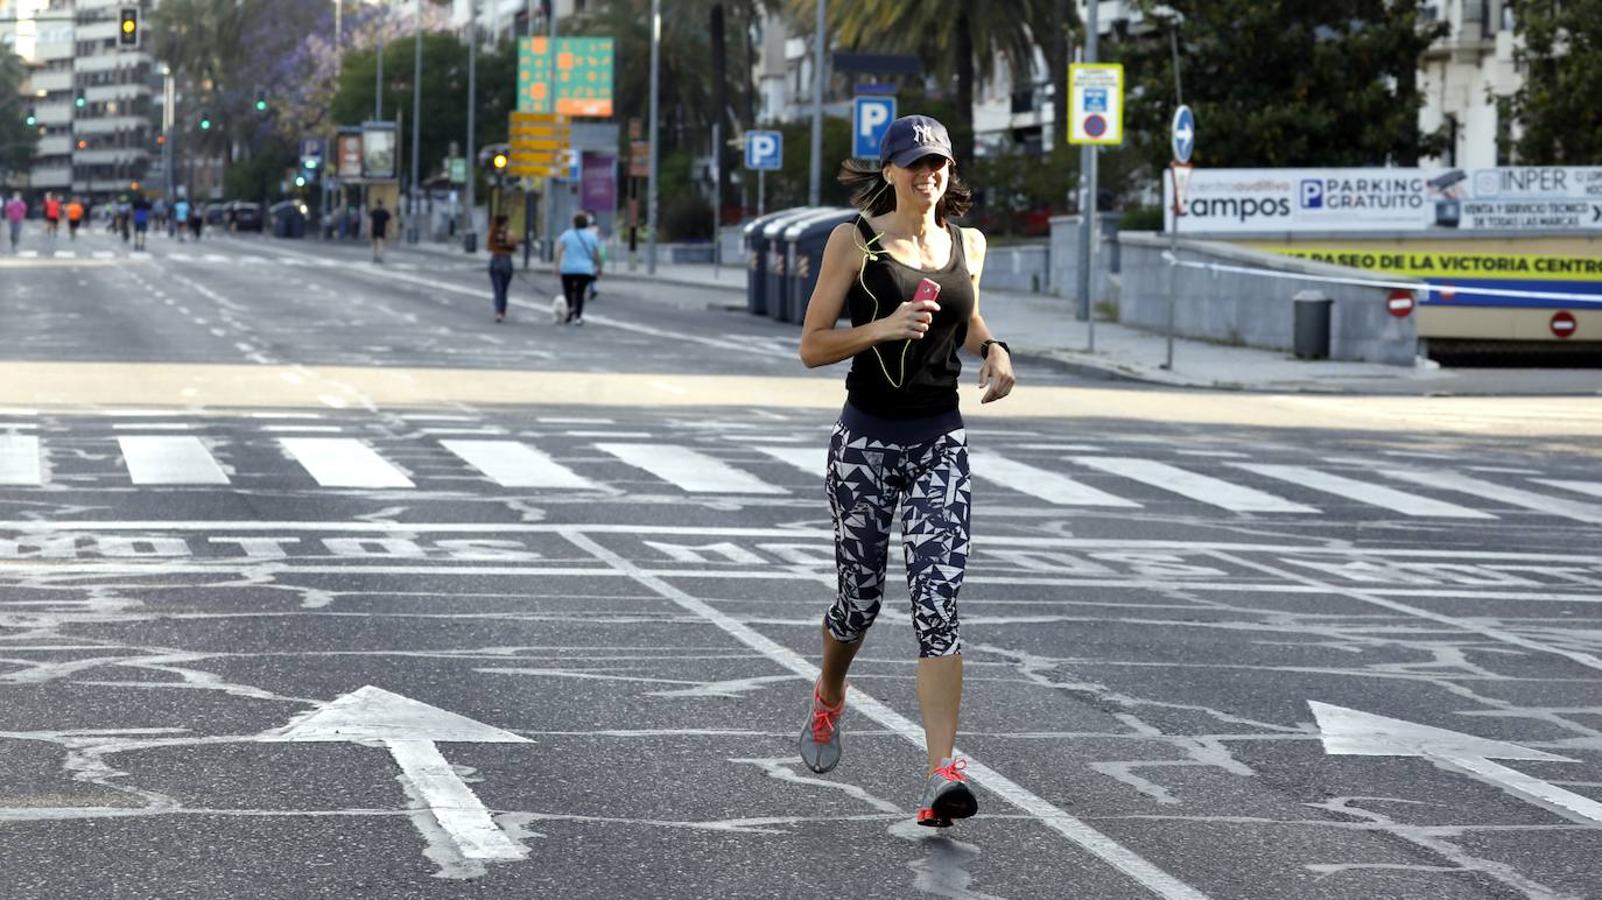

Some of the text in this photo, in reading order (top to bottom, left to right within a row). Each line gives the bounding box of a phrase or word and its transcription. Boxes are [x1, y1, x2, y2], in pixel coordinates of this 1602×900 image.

[861, 102, 888, 136] P
[752, 136, 775, 164] P
[1326, 179, 1423, 192] PARKING
[1502, 168, 1568, 191] INPER
[1326, 194, 1423, 208] GRATUITO
[1505, 203, 1546, 214] SERVICIO
[1488, 216, 1517, 226] TODAS
[1540, 216, 1579, 226] MARCAS
[1380, 254, 1405, 269] DE
[1410, 255, 1434, 270] LA
[1439, 256, 1530, 271] VICTORIA
[1534, 257, 1602, 272] CENTR
